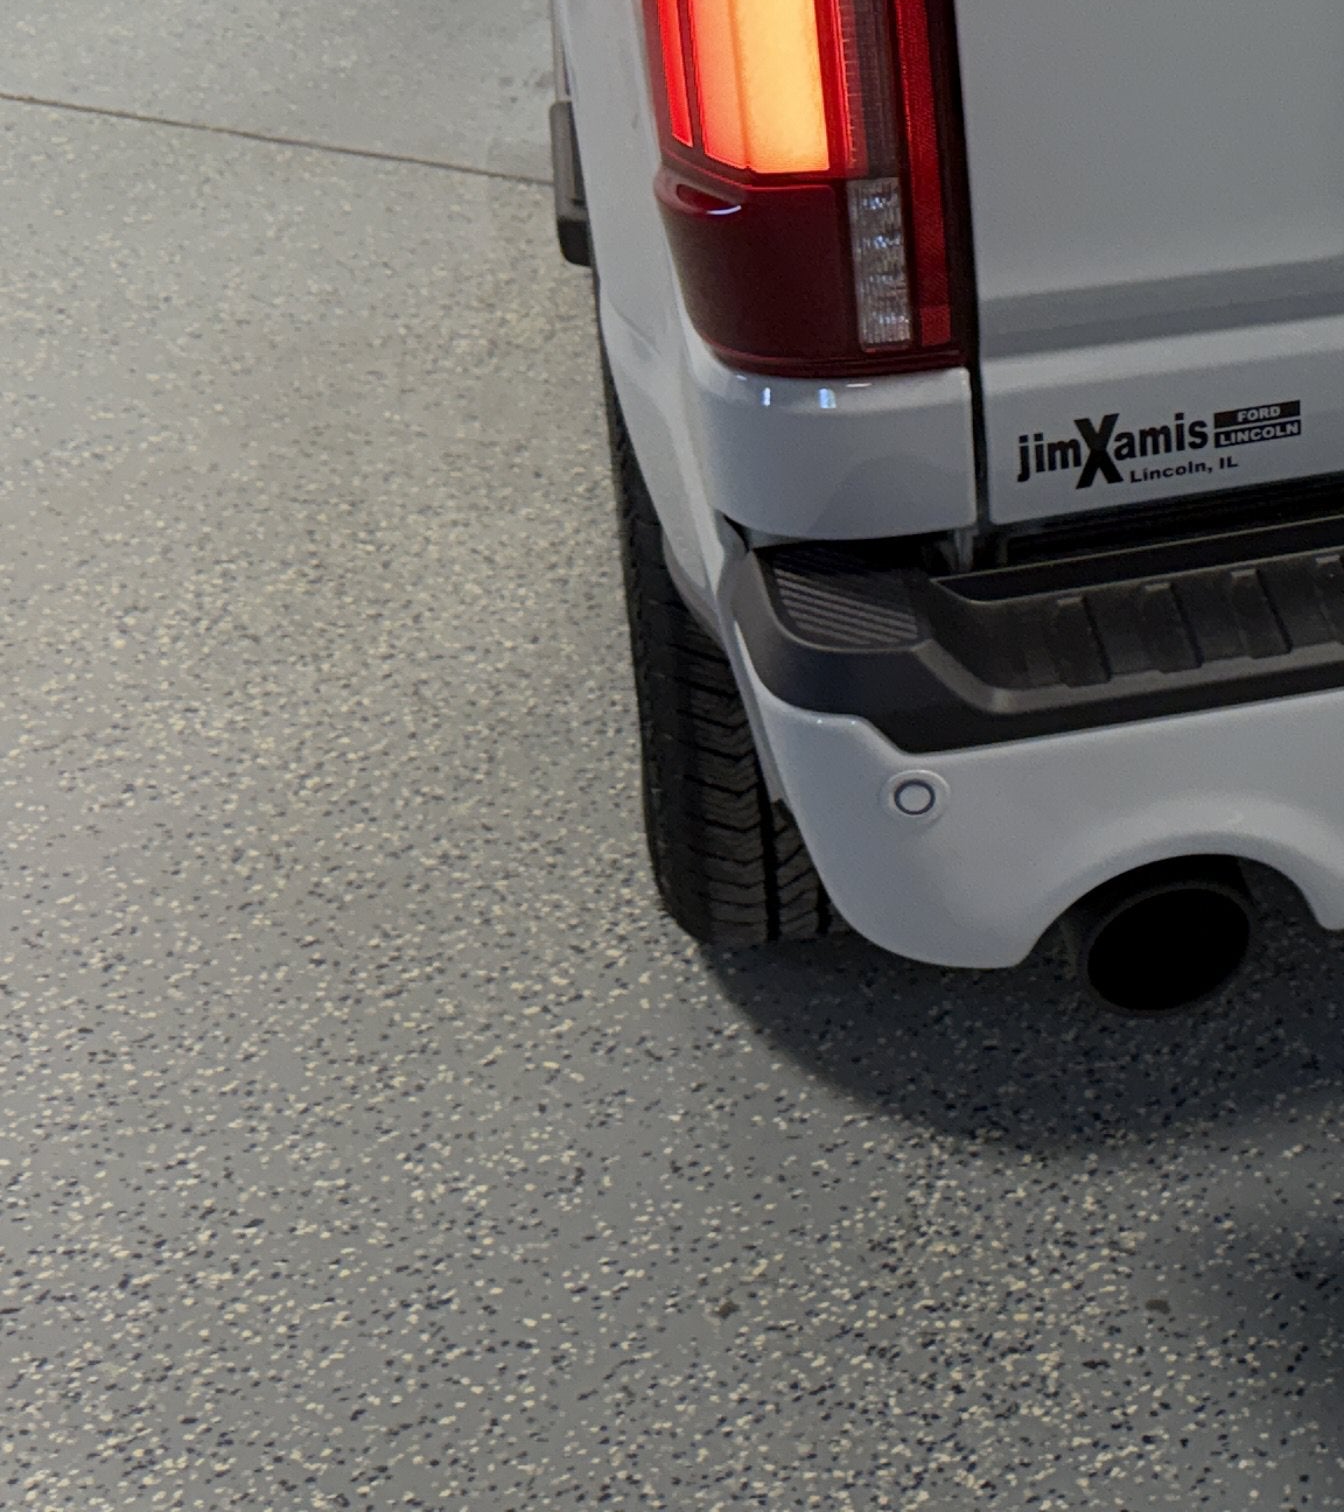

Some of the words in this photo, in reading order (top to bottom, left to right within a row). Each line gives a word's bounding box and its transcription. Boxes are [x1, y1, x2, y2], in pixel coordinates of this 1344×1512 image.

[1236, 405, 1281, 422] FORD
[1218, 422, 1299, 446] LINCOLN
[1130, 460, 1213, 483] Lincoln,
[1219, 456, 1239, 470] IL
